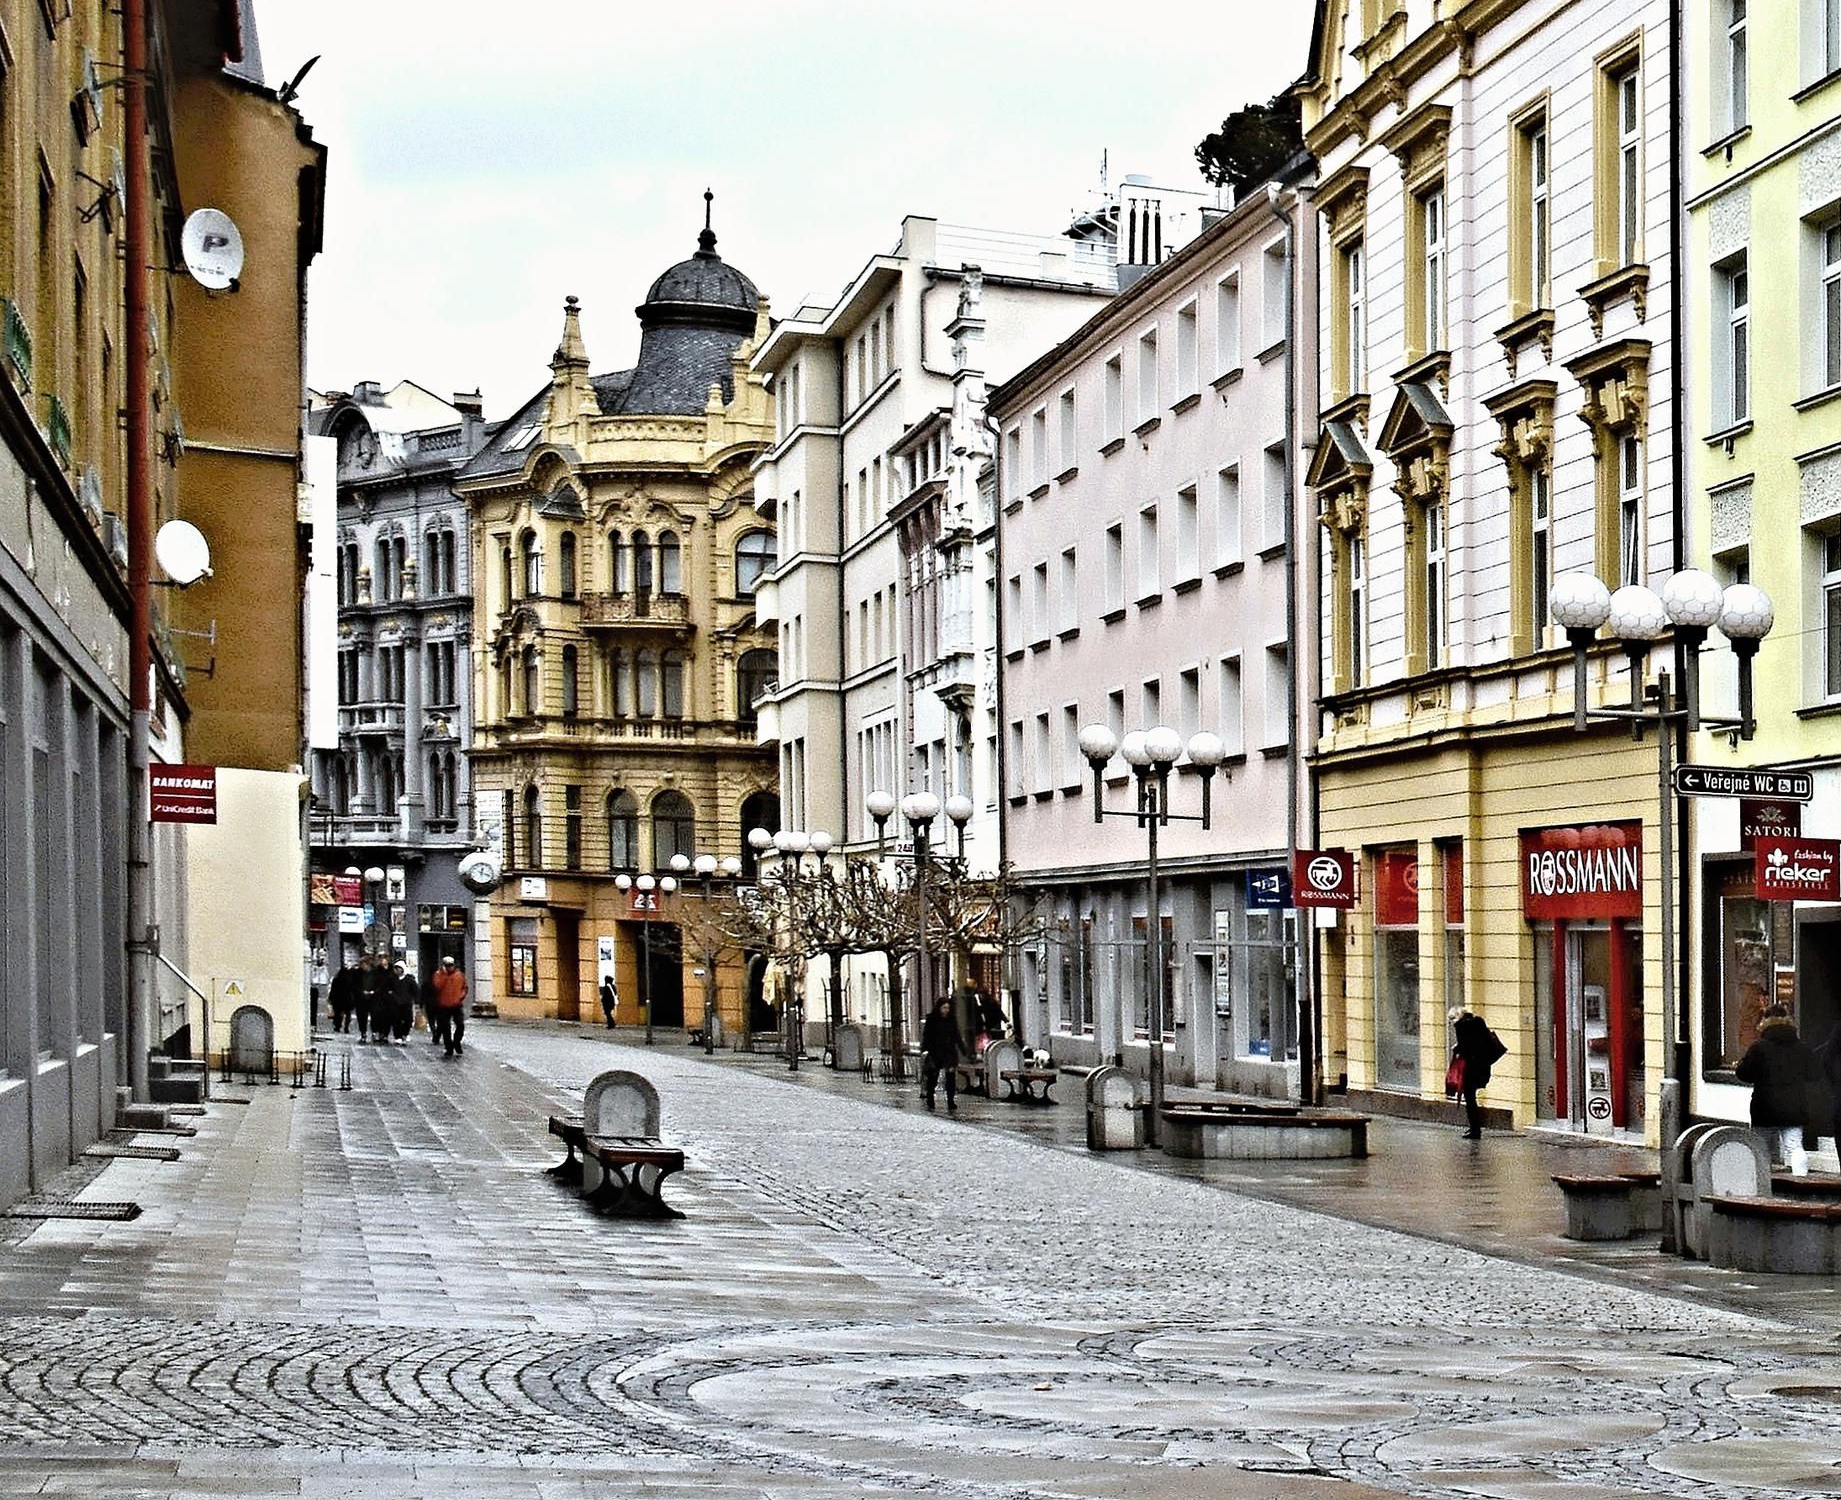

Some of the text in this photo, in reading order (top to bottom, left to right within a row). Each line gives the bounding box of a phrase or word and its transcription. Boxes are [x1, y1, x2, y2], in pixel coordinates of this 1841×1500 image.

[153, 777, 214, 790] BANKOMAT
[1703, 772, 1774, 794] Veřejné WC
[162, 805, 215, 815] UniCredit Bank
[1744, 825, 1798, 838] SATORI
[1823, 850, 1833, 864] by
[1529, 846, 1638, 896] ROSSMANN
[1765, 862, 1831, 882] rieker
[1301, 890, 1350, 900] ROSSMANN
